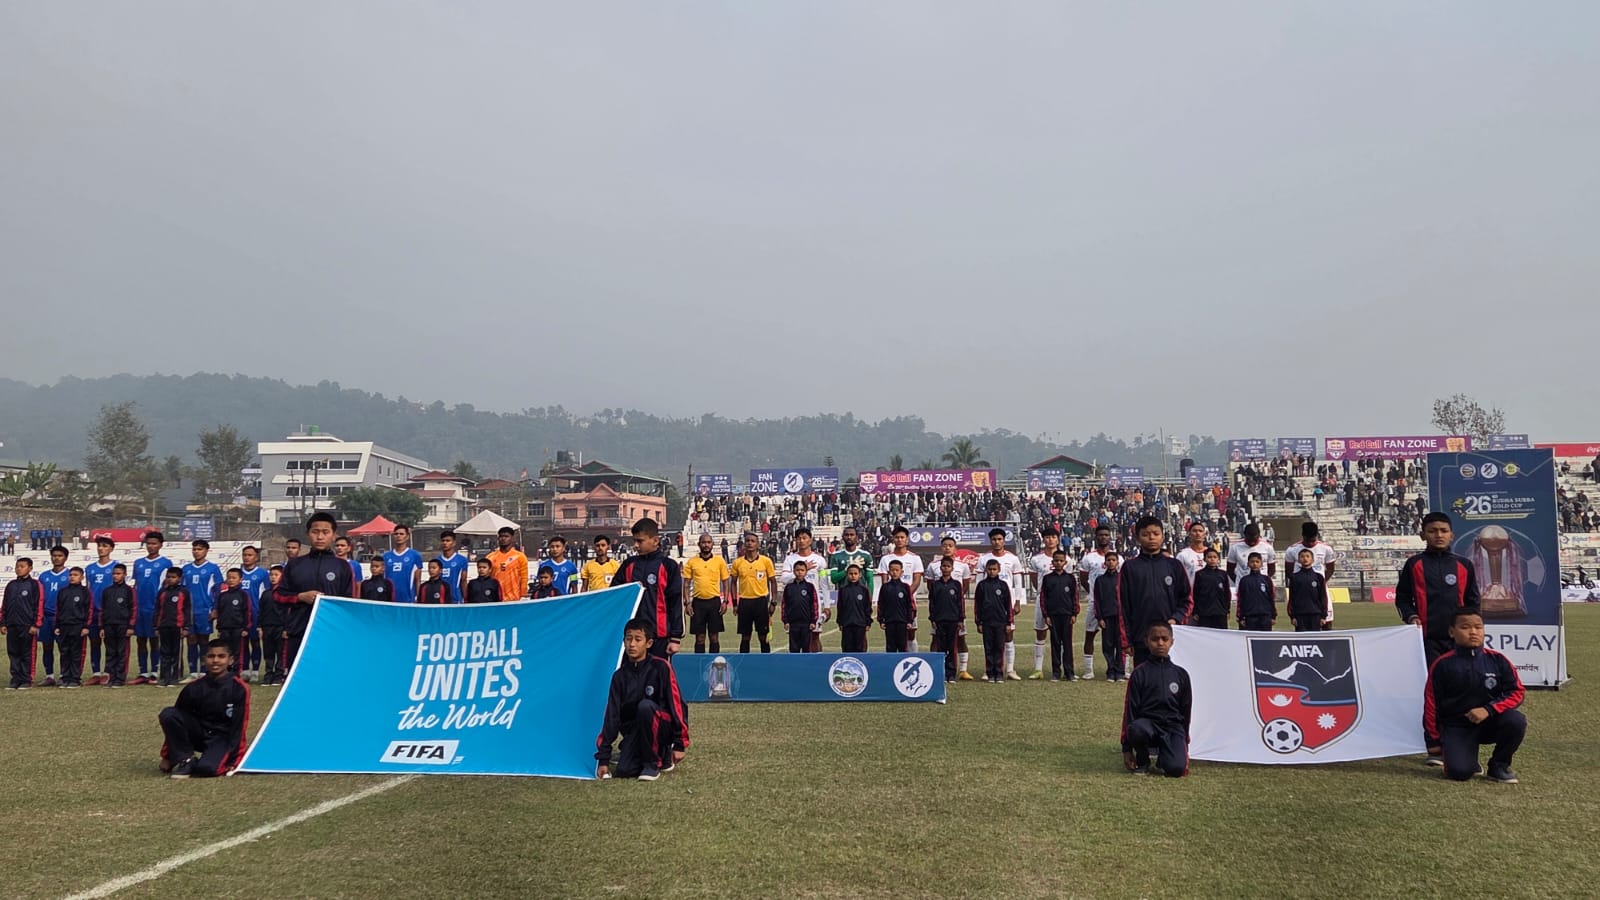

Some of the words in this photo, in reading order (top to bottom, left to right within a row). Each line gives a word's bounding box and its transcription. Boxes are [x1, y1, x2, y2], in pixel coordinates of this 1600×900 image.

[1383, 440, 1405, 448] FAN
[1407, 439, 1437, 448] ZONE
[758, 472, 772, 481] FAN
[913, 473, 933, 482] FAN
[935, 473, 963, 482] ZONE
[751, 481, 778, 493] ZONE
[1465, 495, 1492, 514] 26
[946, 530, 962, 542] 26
[416, 627, 523, 662] FOOTBALL
[1500, 634, 1557, 651] PLAY
[1278, 644, 1324, 658] ANFA
[408, 657, 522, 701] UNITES
[397, 702, 440, 731] the
[441, 698, 522, 730] World
[391, 745, 445, 759] FIFA
